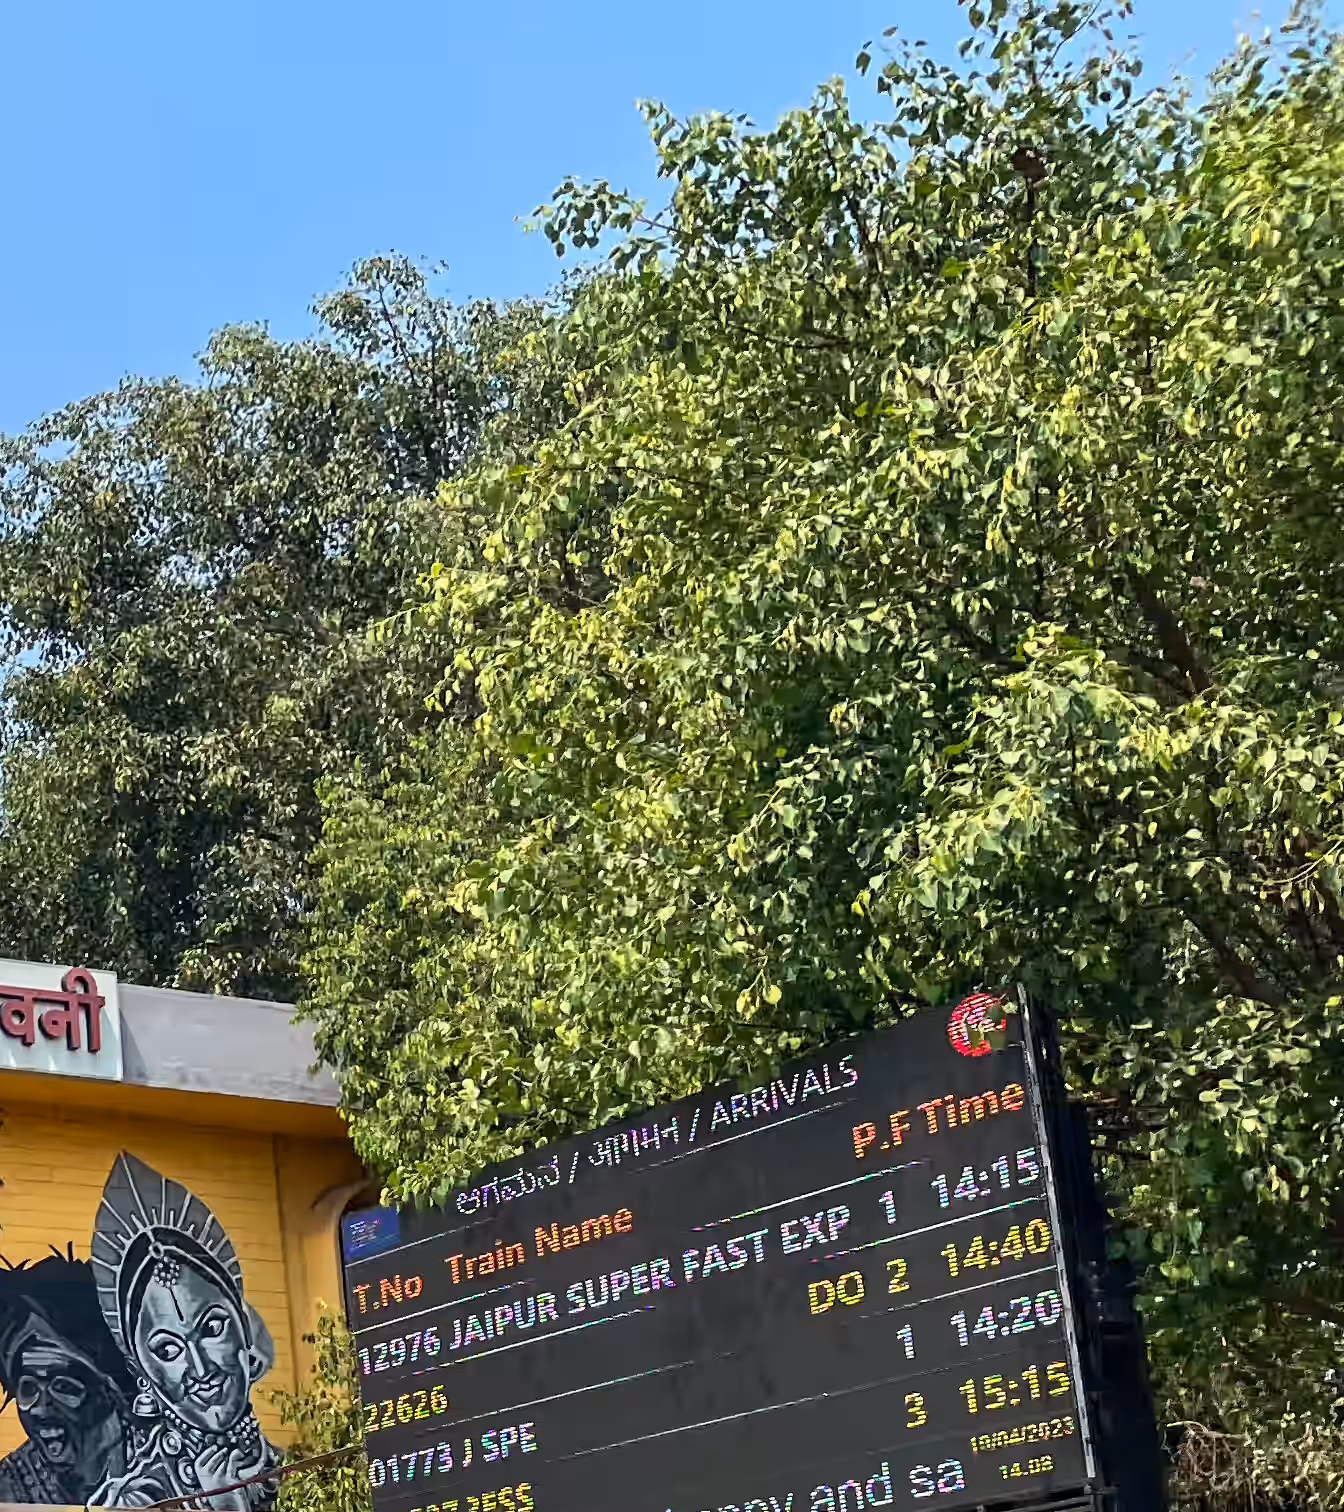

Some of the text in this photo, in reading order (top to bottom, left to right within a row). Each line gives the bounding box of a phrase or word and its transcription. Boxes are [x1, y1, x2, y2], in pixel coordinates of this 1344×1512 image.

[710, 1054, 859, 1131] ARRIVALS
[353, 1081, 1025, 1314] T.No Train Name P.F Time
[358, 1146, 1041, 1375] 12976 JAIPUR SUPER FAST EXP 1 14:15
[362, 1218, 1051, 1433] 22626 DO 2 14:40
[368, 1441, 454, 1488] 01773
[896, 1323, 915, 1360] 1
[950, 1289, 1064, 1347] 14:20
[904, 1392, 927, 1429] 3
[959, 1361, 1071, 1415] 15:15
[909, 1459, 966, 1499] sa
